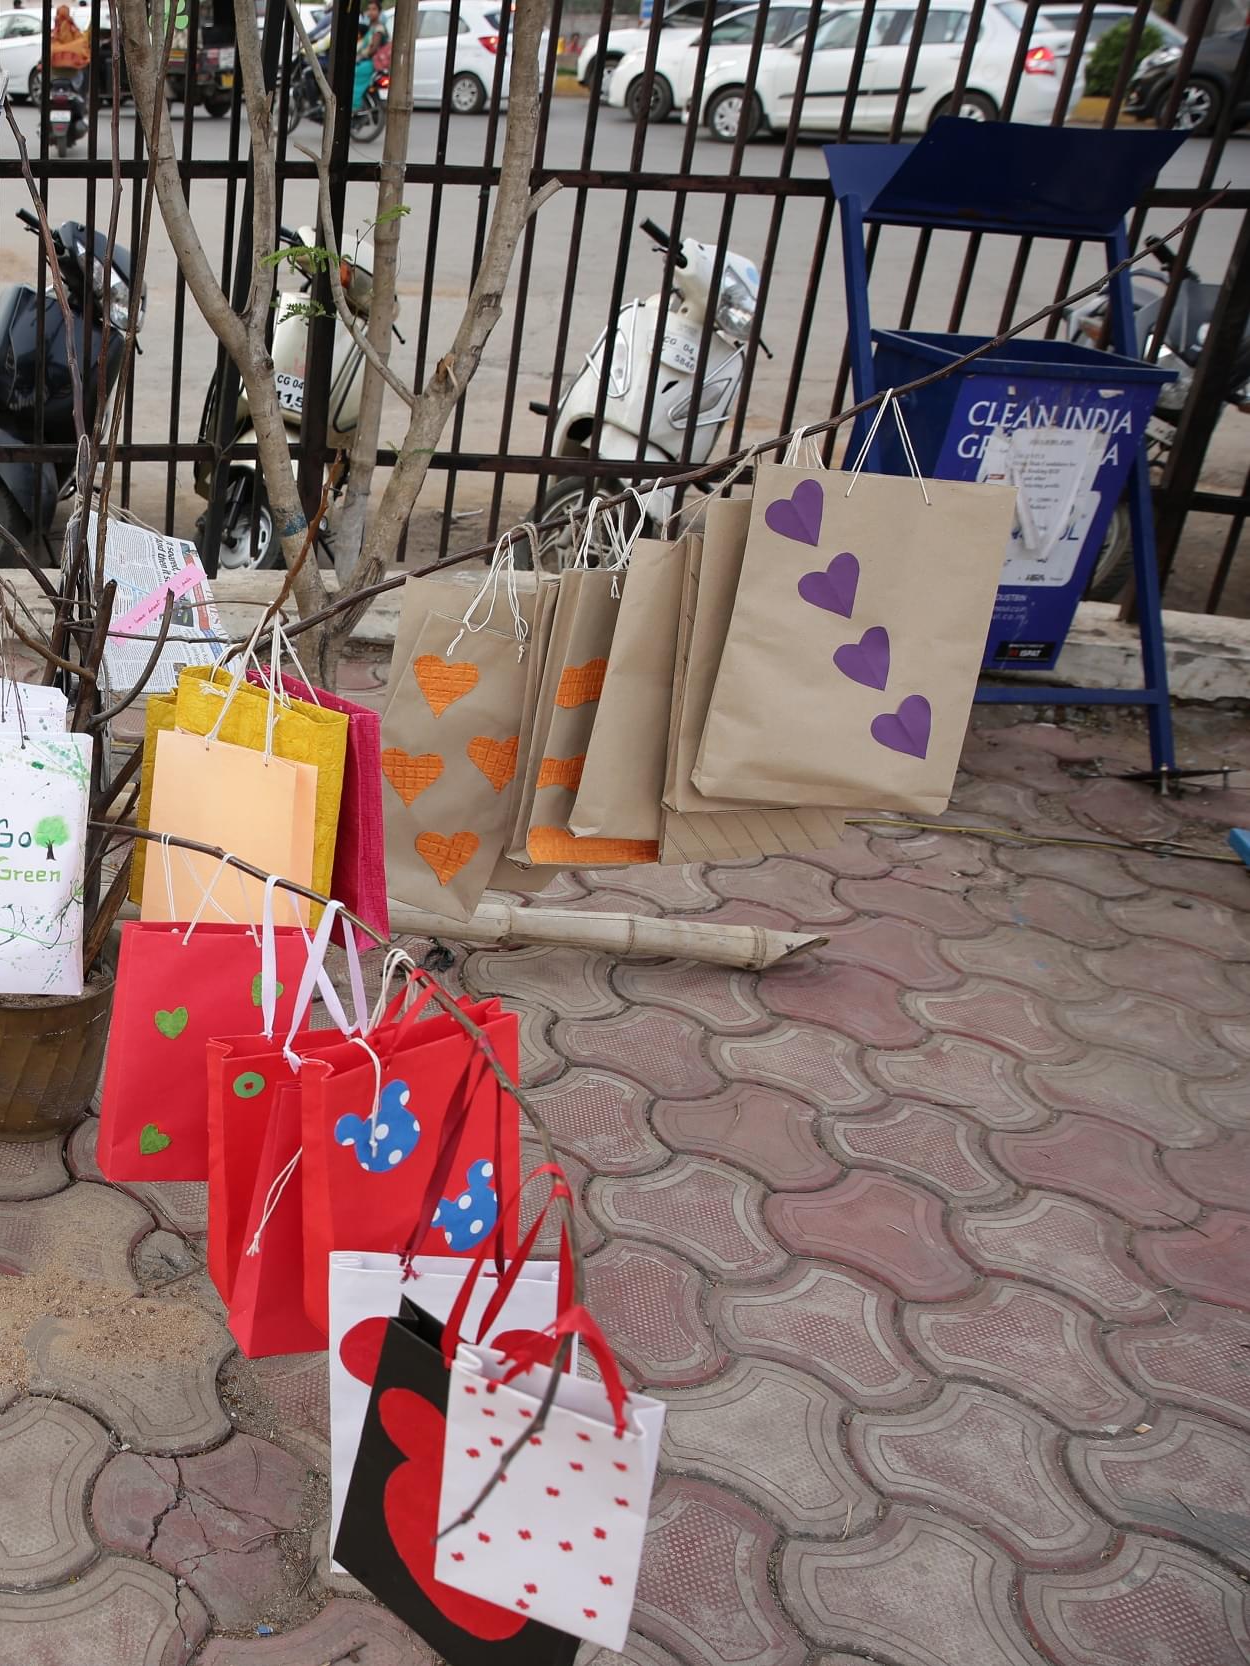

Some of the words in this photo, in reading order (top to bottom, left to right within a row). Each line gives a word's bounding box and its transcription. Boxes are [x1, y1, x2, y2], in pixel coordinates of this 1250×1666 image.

[277, 374, 291, 386] CG
[292, 379, 304, 390] 04
[968, 401, 1058, 429] CLEAN
[1063, 406, 1133, 434] INDIA
